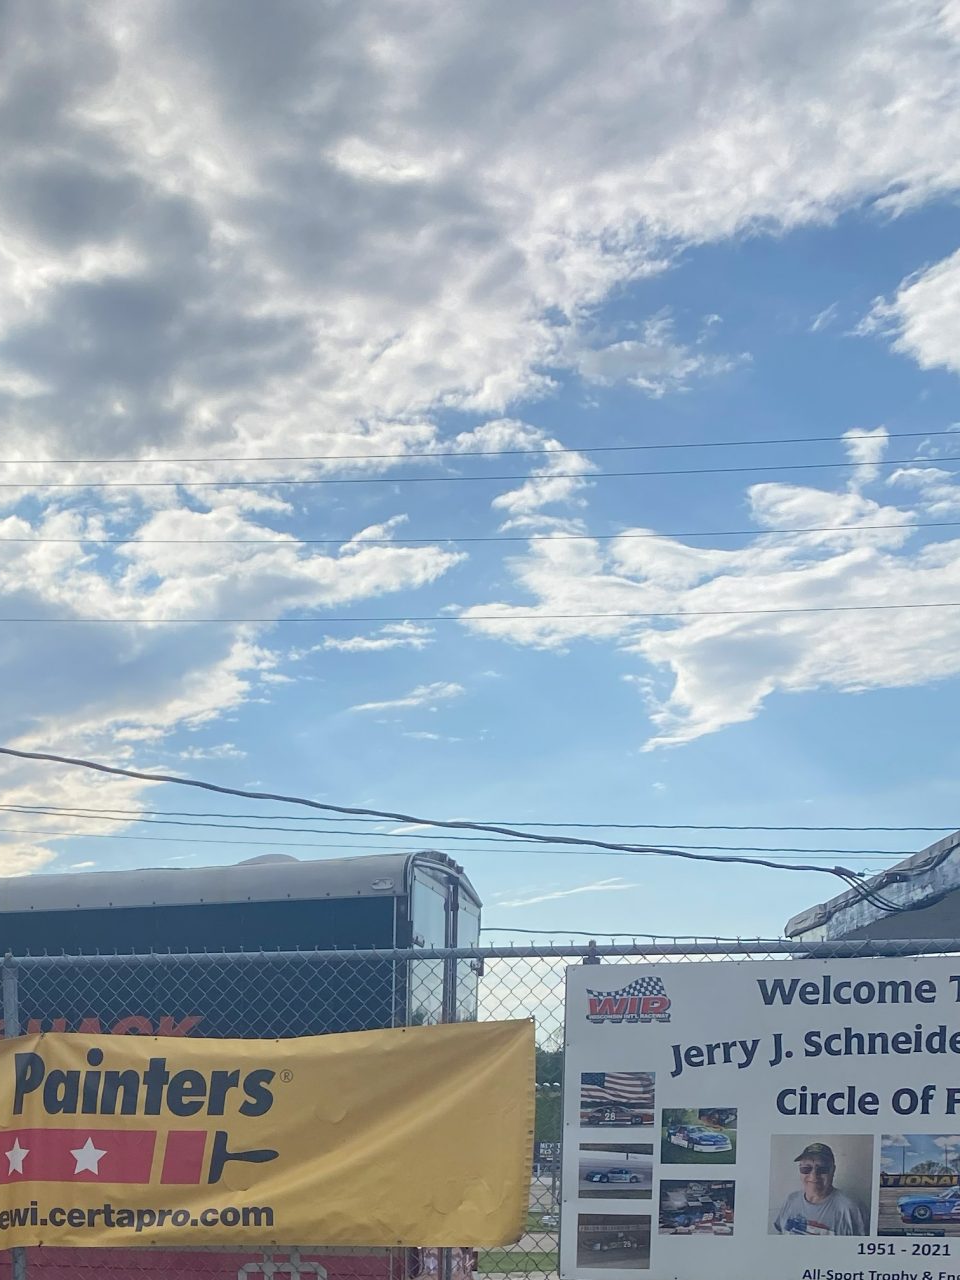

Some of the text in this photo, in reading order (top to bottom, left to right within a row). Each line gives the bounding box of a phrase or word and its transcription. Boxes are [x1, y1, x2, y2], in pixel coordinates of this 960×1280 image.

[587, 995, 671, 1015] WIR
[757, 974, 937, 1006] Welcome
[670, 1039, 760, 1078] Jerry
[768, 1033, 794, 1067] J.
[776, 1085, 880, 1116] Circle
[891, 1084, 937, 1116] Of
[857, 1242, 896, 1256] 1951
[911, 1243, 951, 1257] 2021
